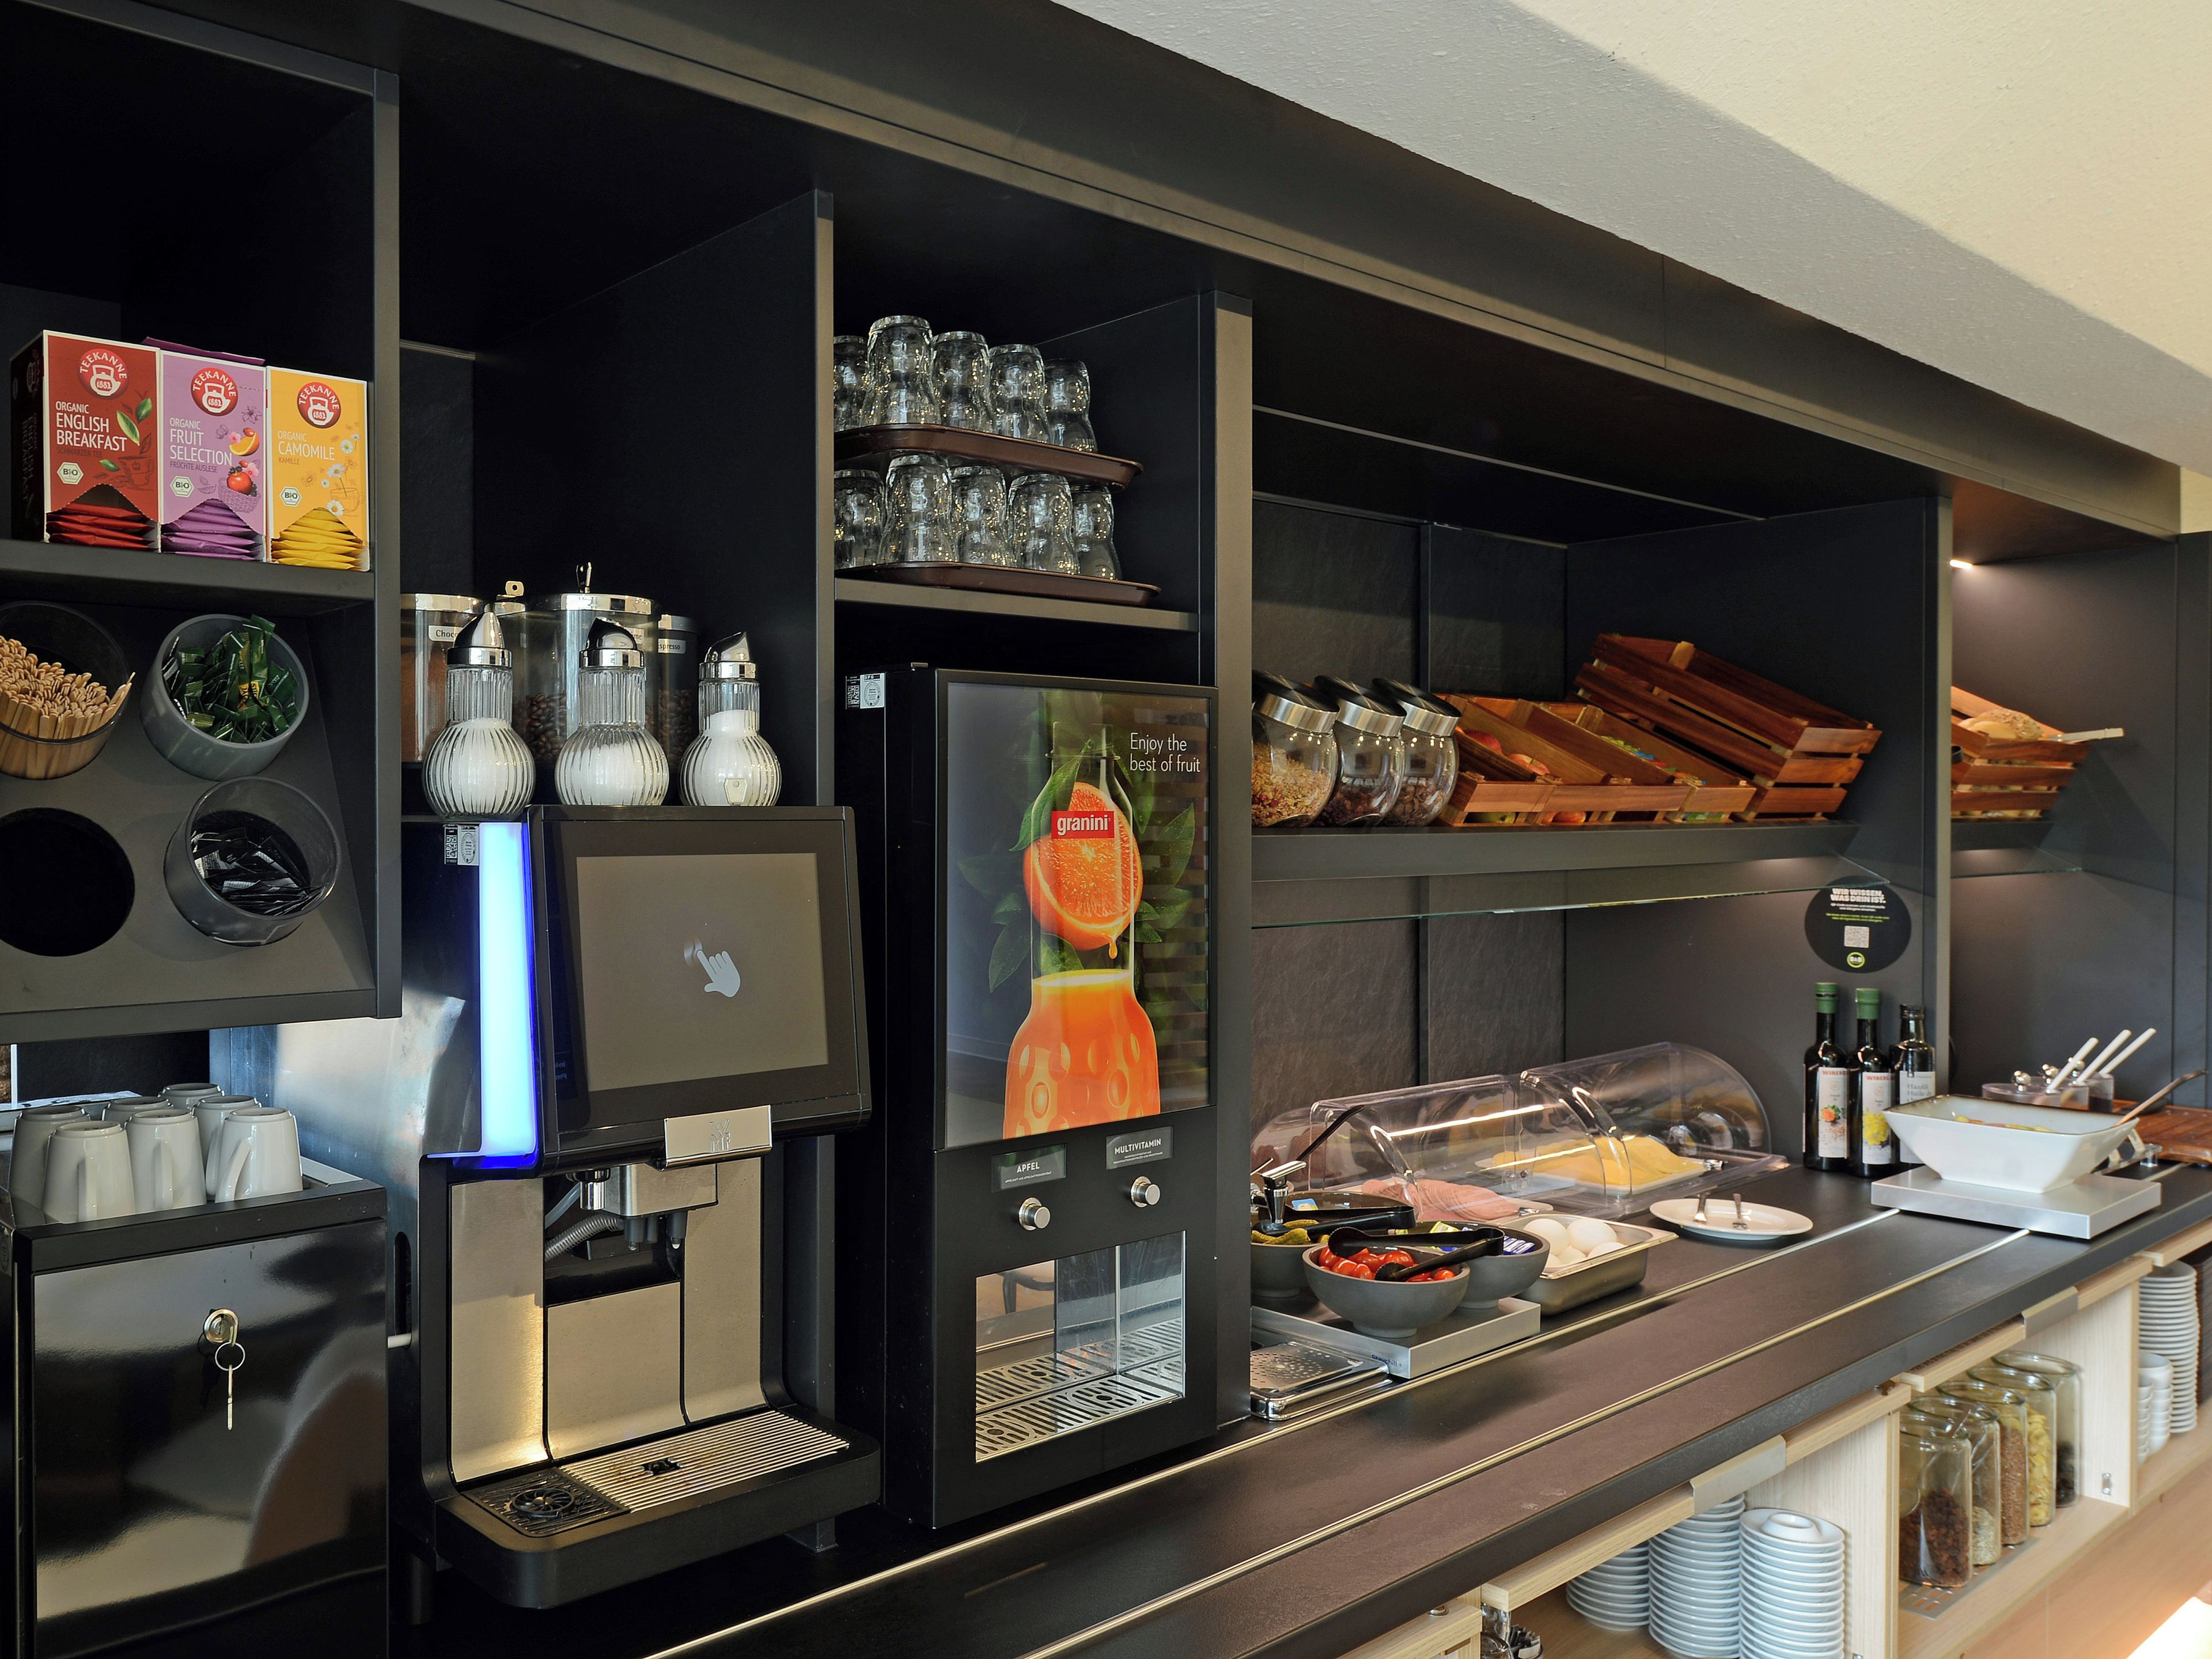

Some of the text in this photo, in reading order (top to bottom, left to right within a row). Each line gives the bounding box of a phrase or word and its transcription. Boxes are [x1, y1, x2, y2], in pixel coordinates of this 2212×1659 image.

[79, 351, 128, 379] TEEKANNE
[97, 380, 112, 390] 1882
[192, 370, 237, 397] TEEKANNE
[208, 397, 222, 407] 1882
[298, 384, 340, 410] TEEKANNE
[55, 401, 89, 414] ORGANIC
[313, 411, 327, 420] 1882
[56, 412, 109, 433] ENGLISH
[169, 417, 201, 430] ORGANIC
[56, 430, 127, 452] BREAKFAST
[170, 429, 204, 446] FRUIT
[278, 431, 307, 441] ORGANIC
[170, 445, 232, 465] SELECTION
[278, 441, 335, 460] CAMOMILE
[170, 460, 218, 472] FRÜCHTE AUSLESE
[278, 457, 300, 465] KAMILLE
[1130, 732, 1187, 755] Enjoy the
[1130, 753, 1201, 772] best of fruit
[1057, 815, 1108, 836] granini
[1114, 1138, 1162, 1154] MULTIVITAMIN
[1016, 1161, 1040, 1173] APFEL
